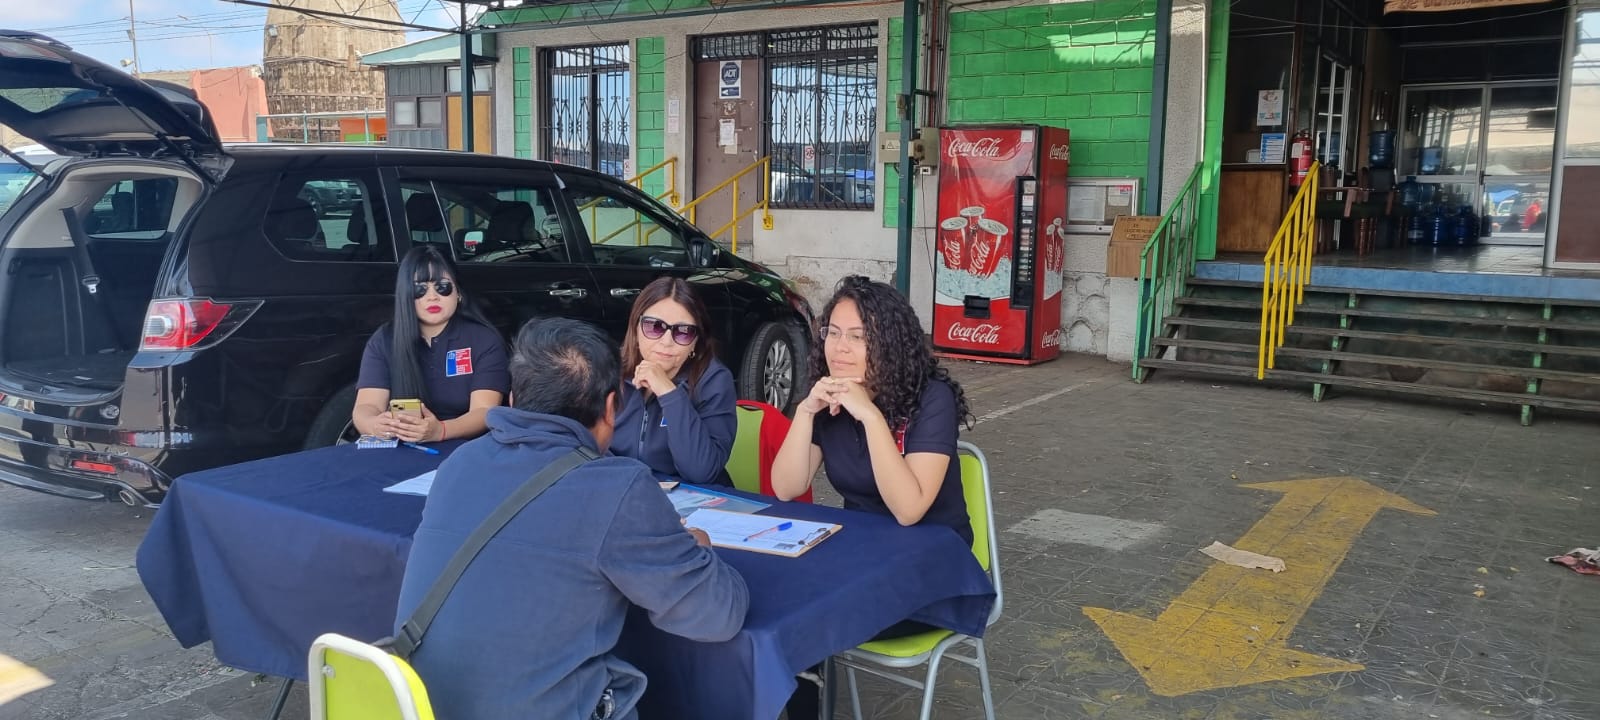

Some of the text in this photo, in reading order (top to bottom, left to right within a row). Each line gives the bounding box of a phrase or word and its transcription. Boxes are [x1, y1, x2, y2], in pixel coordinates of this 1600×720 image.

[724, 69, 737, 78] ADT
[948, 137, 1002, 158] Coca-Cola
[948, 321, 1002, 345] Coca-Cola
